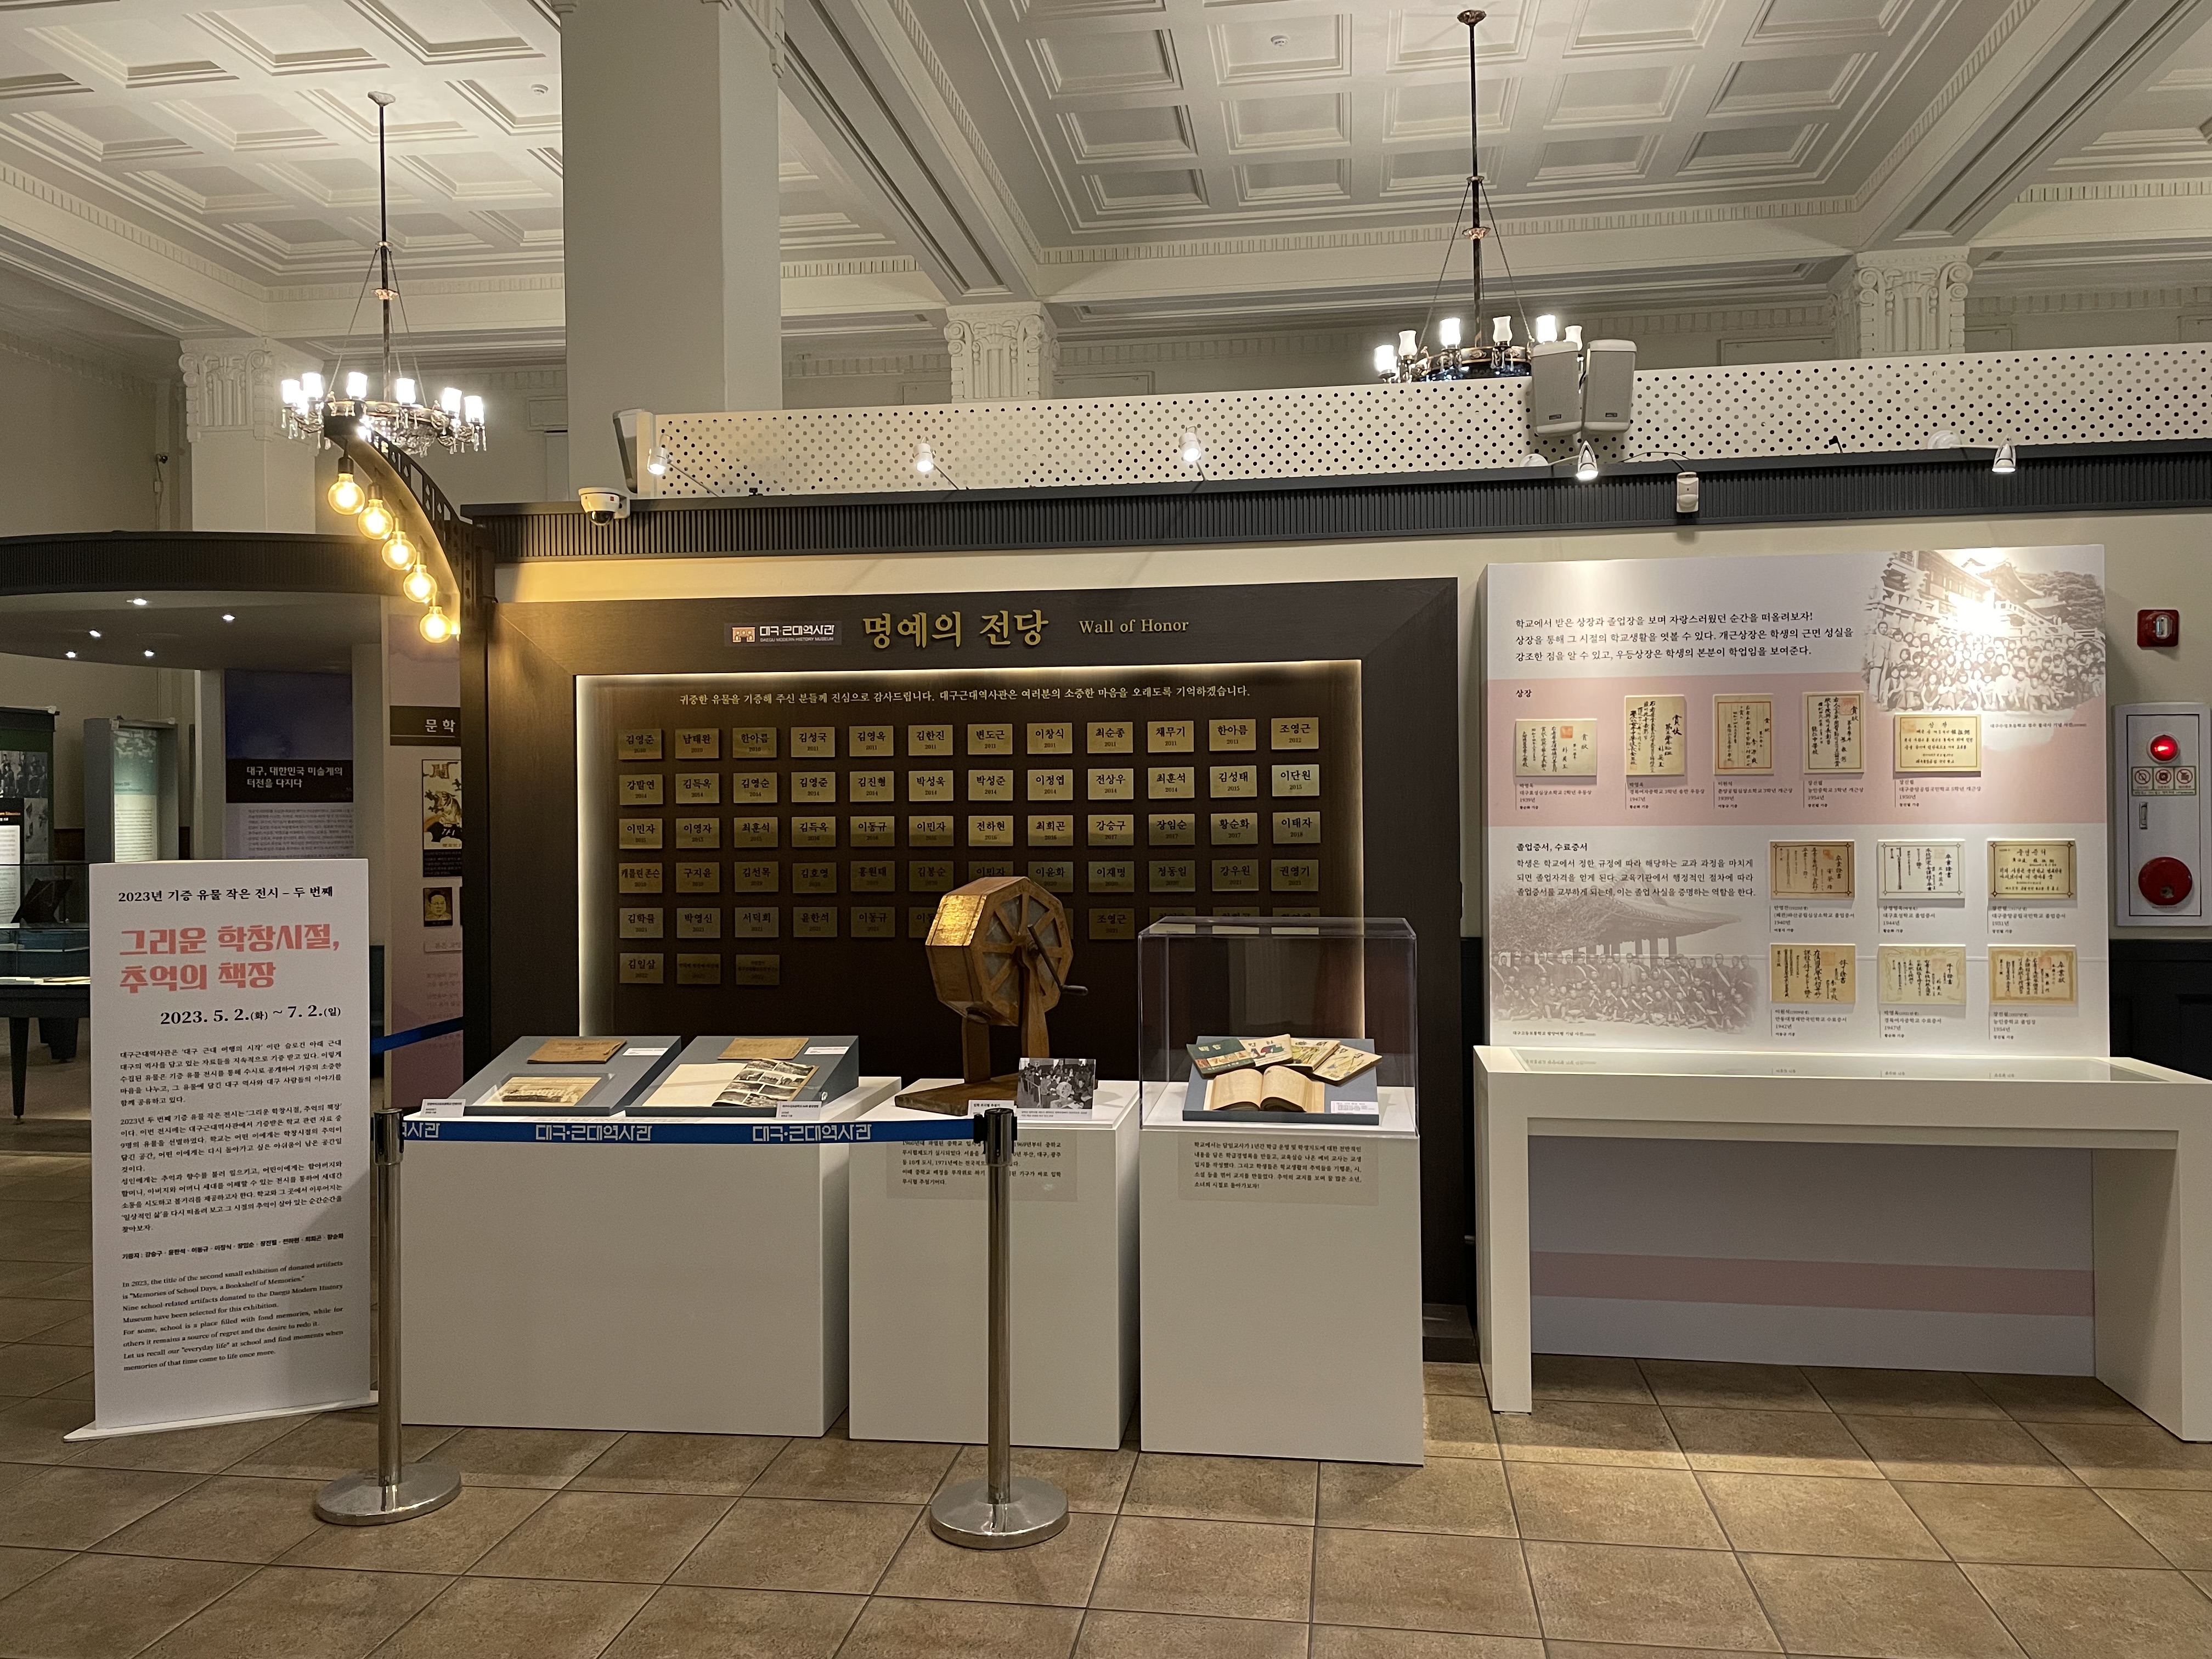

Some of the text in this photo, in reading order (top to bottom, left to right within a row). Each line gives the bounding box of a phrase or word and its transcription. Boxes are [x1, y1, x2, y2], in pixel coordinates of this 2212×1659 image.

[1516, 612, 1812, 629] 학교에서 받은 상장과 졸업장을 보며 자랑스러웠던 순간을 떠올려보자!
[863, 610, 1048, 648] 명예의 전당
[1079, 619, 1188, 633] Wall of Honor
[1516, 636, 1543, 645] 상장을
[1547, 635, 1564, 644] 통해
[1580, 634, 1606, 643] 시절의
[1611, 633, 1657, 642] 학교생활을
[1661, 632, 1679, 641] 엿볼
[1683, 632, 1691, 640] 수
[1695, 631, 1716, 640] 있다.
[1720, 630, 1767, 640] 개근상장은
[1771, 629, 1797, 639] 학생의
[1802, 628, 1820, 637] 근면
[1825, 628, 1853, 637] 성실을
[1516, 646, 1811, 662] 강조한 점을 알 수 있고, 우등상장은 학생의 본분이 학업임을 보여준다.
[680, 686, 1249, 705] 귀중한 유물을 기증해 주신 분들께 진심으로 감사드립니다. 대구근대역사관은 여러분의 소중한 마음을 오래도록 기억하겠습니다.
[1096, 728, 1125, 738] 최순종
[1217, 725, 1248, 735] 한아름
[1280, 724, 1311, 733] 조영근
[741, 733, 769, 743] 한아름
[857, 731, 885, 741] 김영옥
[917, 730, 944, 741] 김한진
[977, 730, 1005, 740] 변도근
[1036, 729, 1063, 739] 이창식
[626, 735, 654, 744] 김영준
[247, 766, 267, 776] 대구,
[270, 767, 304, 776] 대한민국
[1281, 770, 1311, 781] 이단원
[977, 776, 1006, 786] 박성준
[1036, 775, 1064, 785] 이정엽
[1096, 774, 1125, 785] 전상우
[1156, 773, 1185, 783] 최훈석
[1218, 771, 1248, 782] 김성태
[247, 778, 302, 788] 터전을 다지다
[742, 778, 769, 788] 김영순
[799, 777, 827, 787] 김영준
[119, 890, 162, 901] 2023년
[168, 890, 192, 901] 기증
[197, 890, 222, 900] 유물
[226, 889, 250, 900] 작은
[256, 888, 278, 899] 전시
[294, 888, 305, 898] 두
[310, 887, 332, 897] 번째
[1517, 888, 1555, 896] 졸업증서를
[1558, 888, 1587, 896] 교부하게
[1635, 888, 1649, 896] 졸업
[1652, 888, 1675, 896] 사실을
[1678, 888, 1709, 896] 증명하는
[1712, 888, 1735, 896] 역할을
[1738, 888, 1756, 896] 한다.
[120, 924, 339, 955] 그리운 학창시절,
[120, 962, 276, 994] 추억의 책장
[161, 1011, 207, 1024] 2023.
[214, 1010, 228, 1022] 5.
[288, 1006, 302, 1018] 7.
